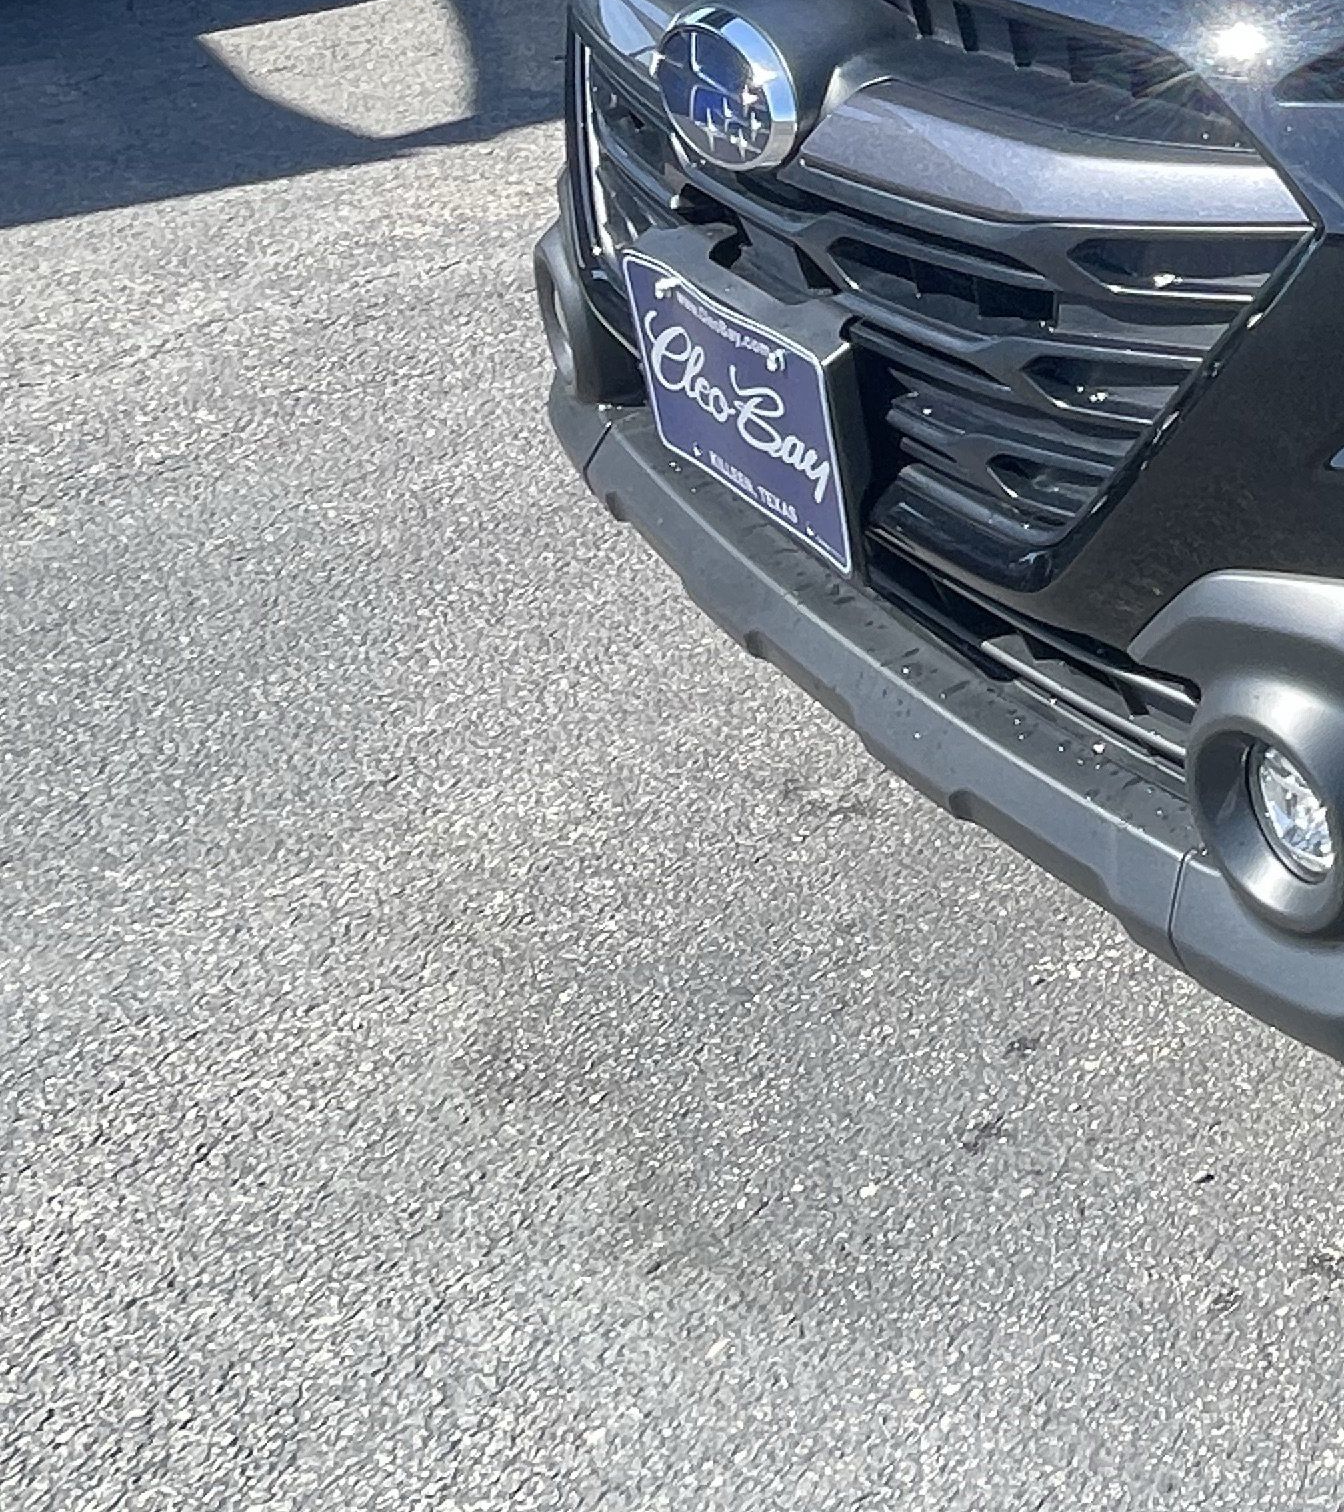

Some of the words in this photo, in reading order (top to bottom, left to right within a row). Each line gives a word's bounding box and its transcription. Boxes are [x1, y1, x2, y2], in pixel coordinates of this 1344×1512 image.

[643, 310, 736, 424] Cleo
[730, 365, 832, 504] Bay
[757, 486, 798, 524] TEXAS
